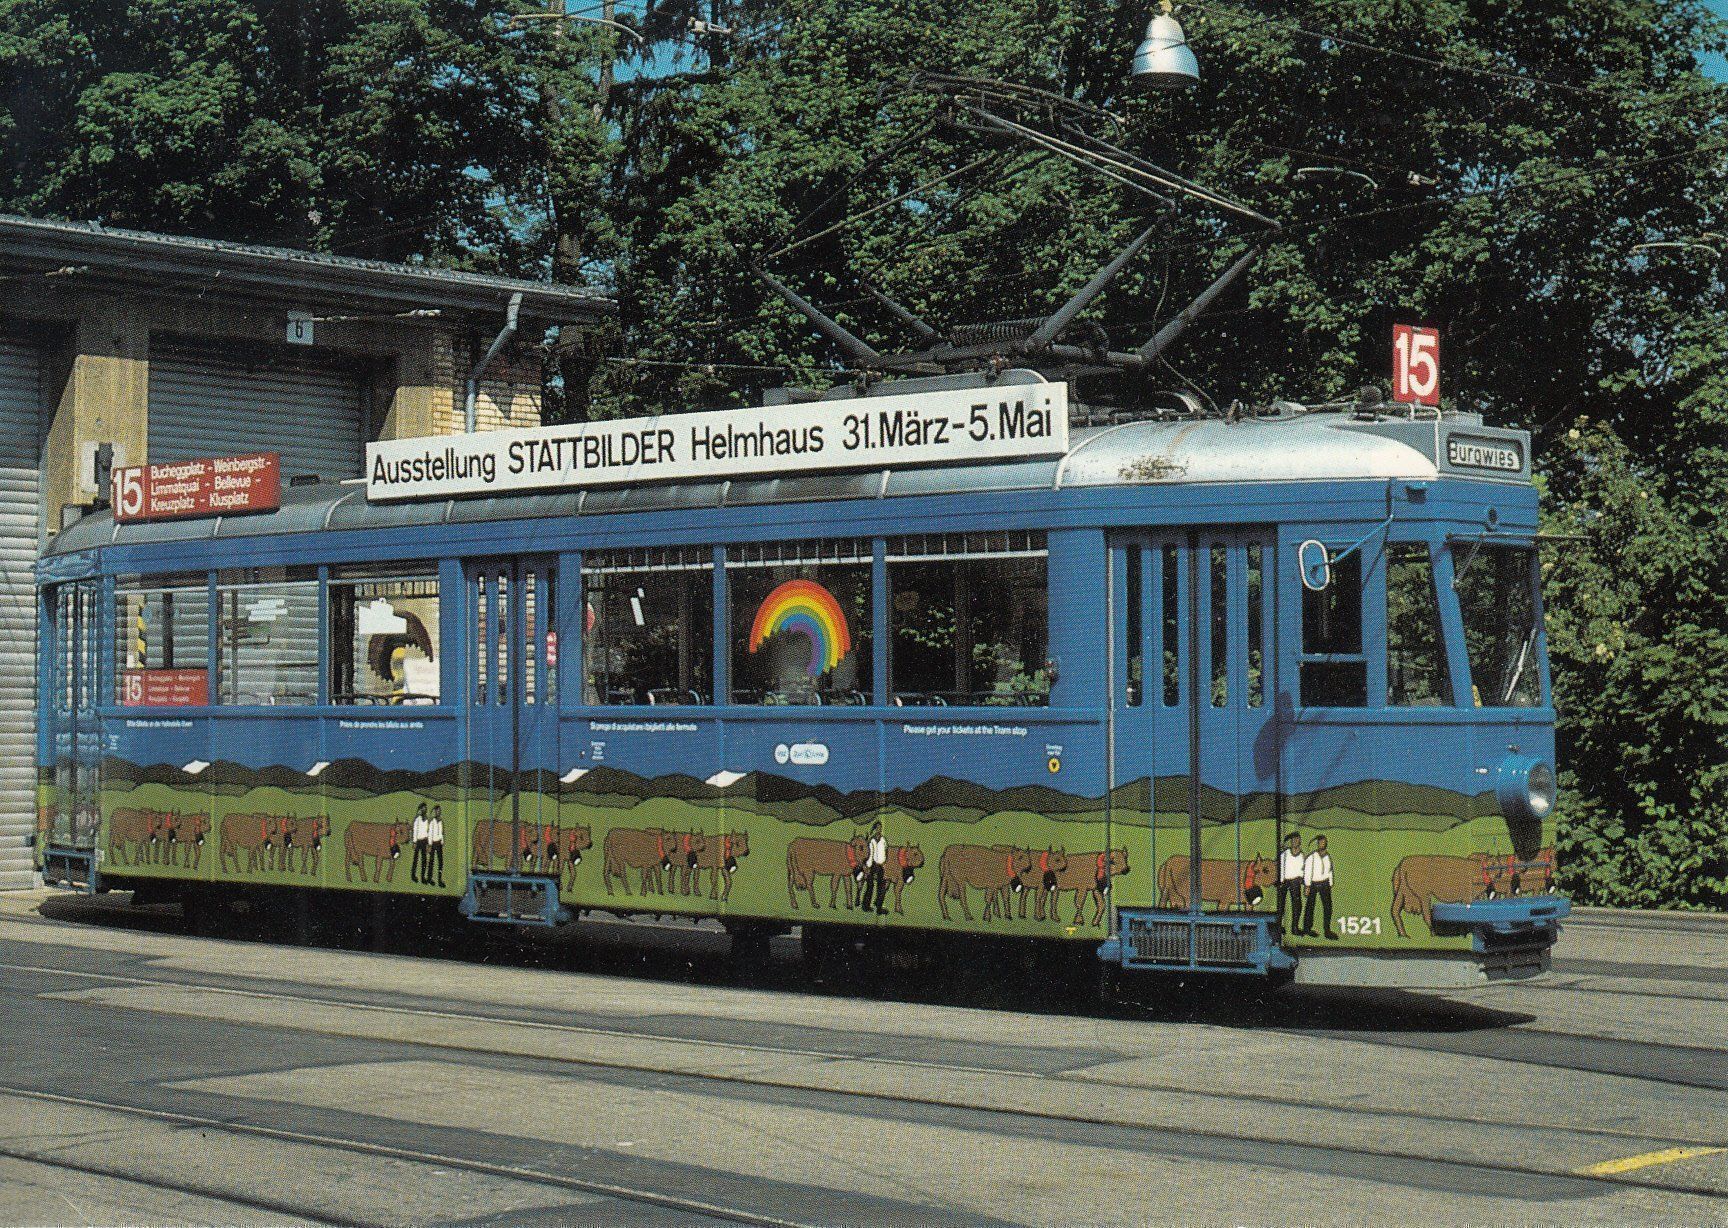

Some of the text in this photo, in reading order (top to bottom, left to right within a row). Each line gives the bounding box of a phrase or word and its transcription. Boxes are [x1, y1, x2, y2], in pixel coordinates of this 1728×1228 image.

[296, 320, 303, 338] 6
[1396, 332, 1437, 396] 15
[372, 447, 496, 485] Ausstellung
[508, 429, 675, 474] STATTBILDER
[691, 420, 824, 461] Helmhaus
[151, 462, 205, 481] Bucheggplatz
[113, 468, 143, 517] 15
[151, 478, 200, 496] Limmatquai
[214, 475, 251, 491] Bellevue
[209, 491, 249, 509] Klusplatz
[125, 675, 142, 701] 15
[1337, 916, 1381, 935] 1521
